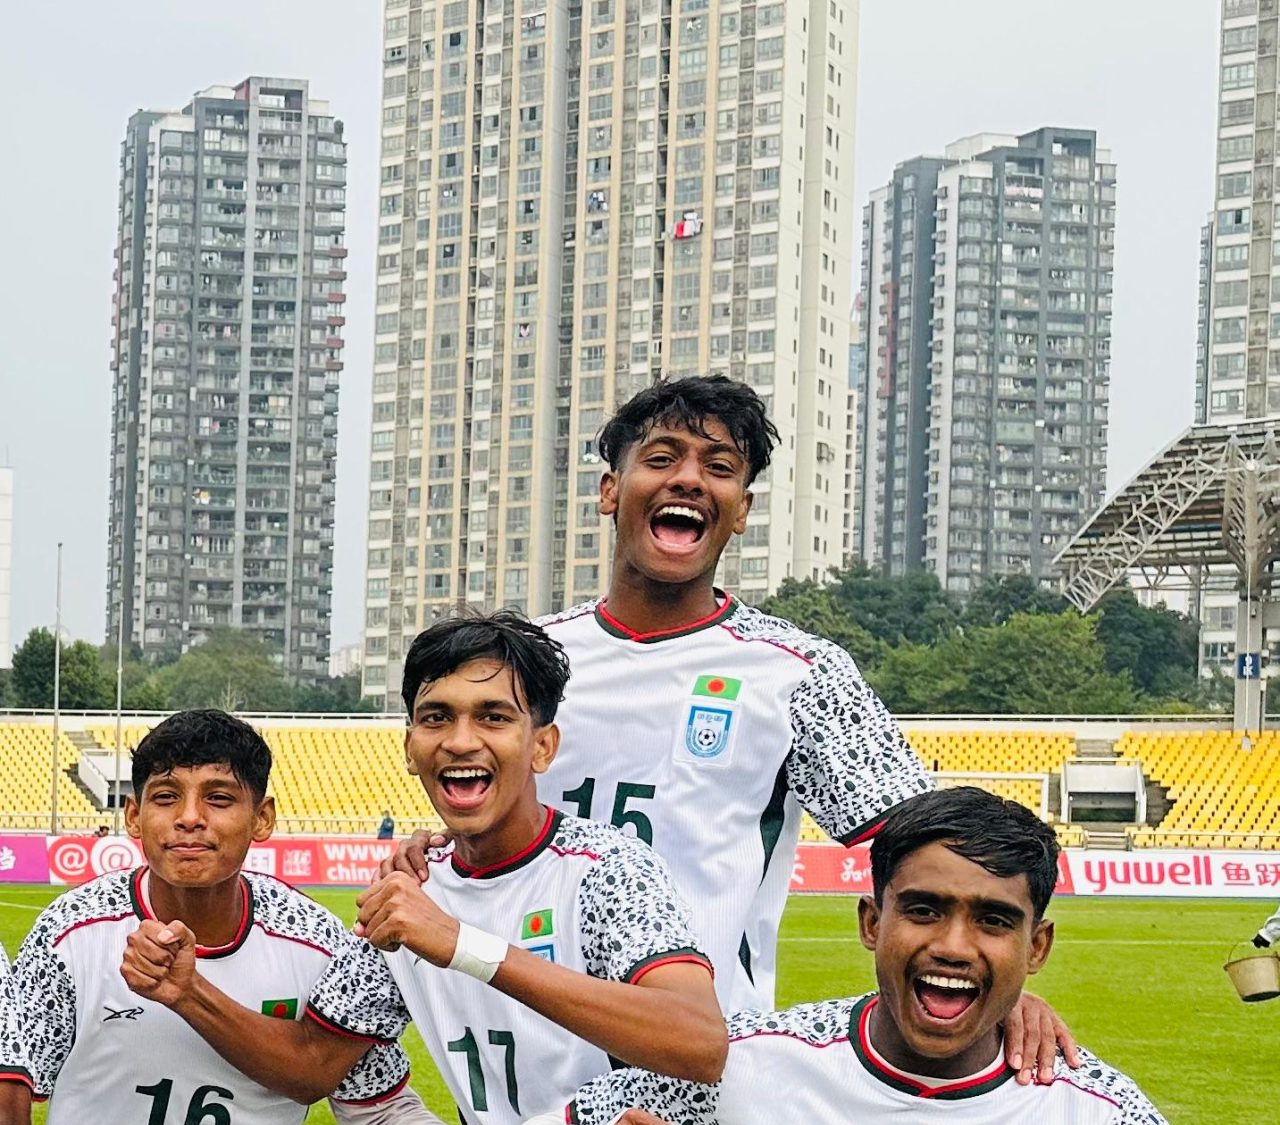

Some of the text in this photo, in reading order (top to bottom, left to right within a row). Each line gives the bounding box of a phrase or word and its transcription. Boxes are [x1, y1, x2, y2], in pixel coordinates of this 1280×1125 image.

[327, 863, 377, 881] chin
[1084, 856, 1212, 893] yuwell
[448, 1026, 520, 1117] 17
